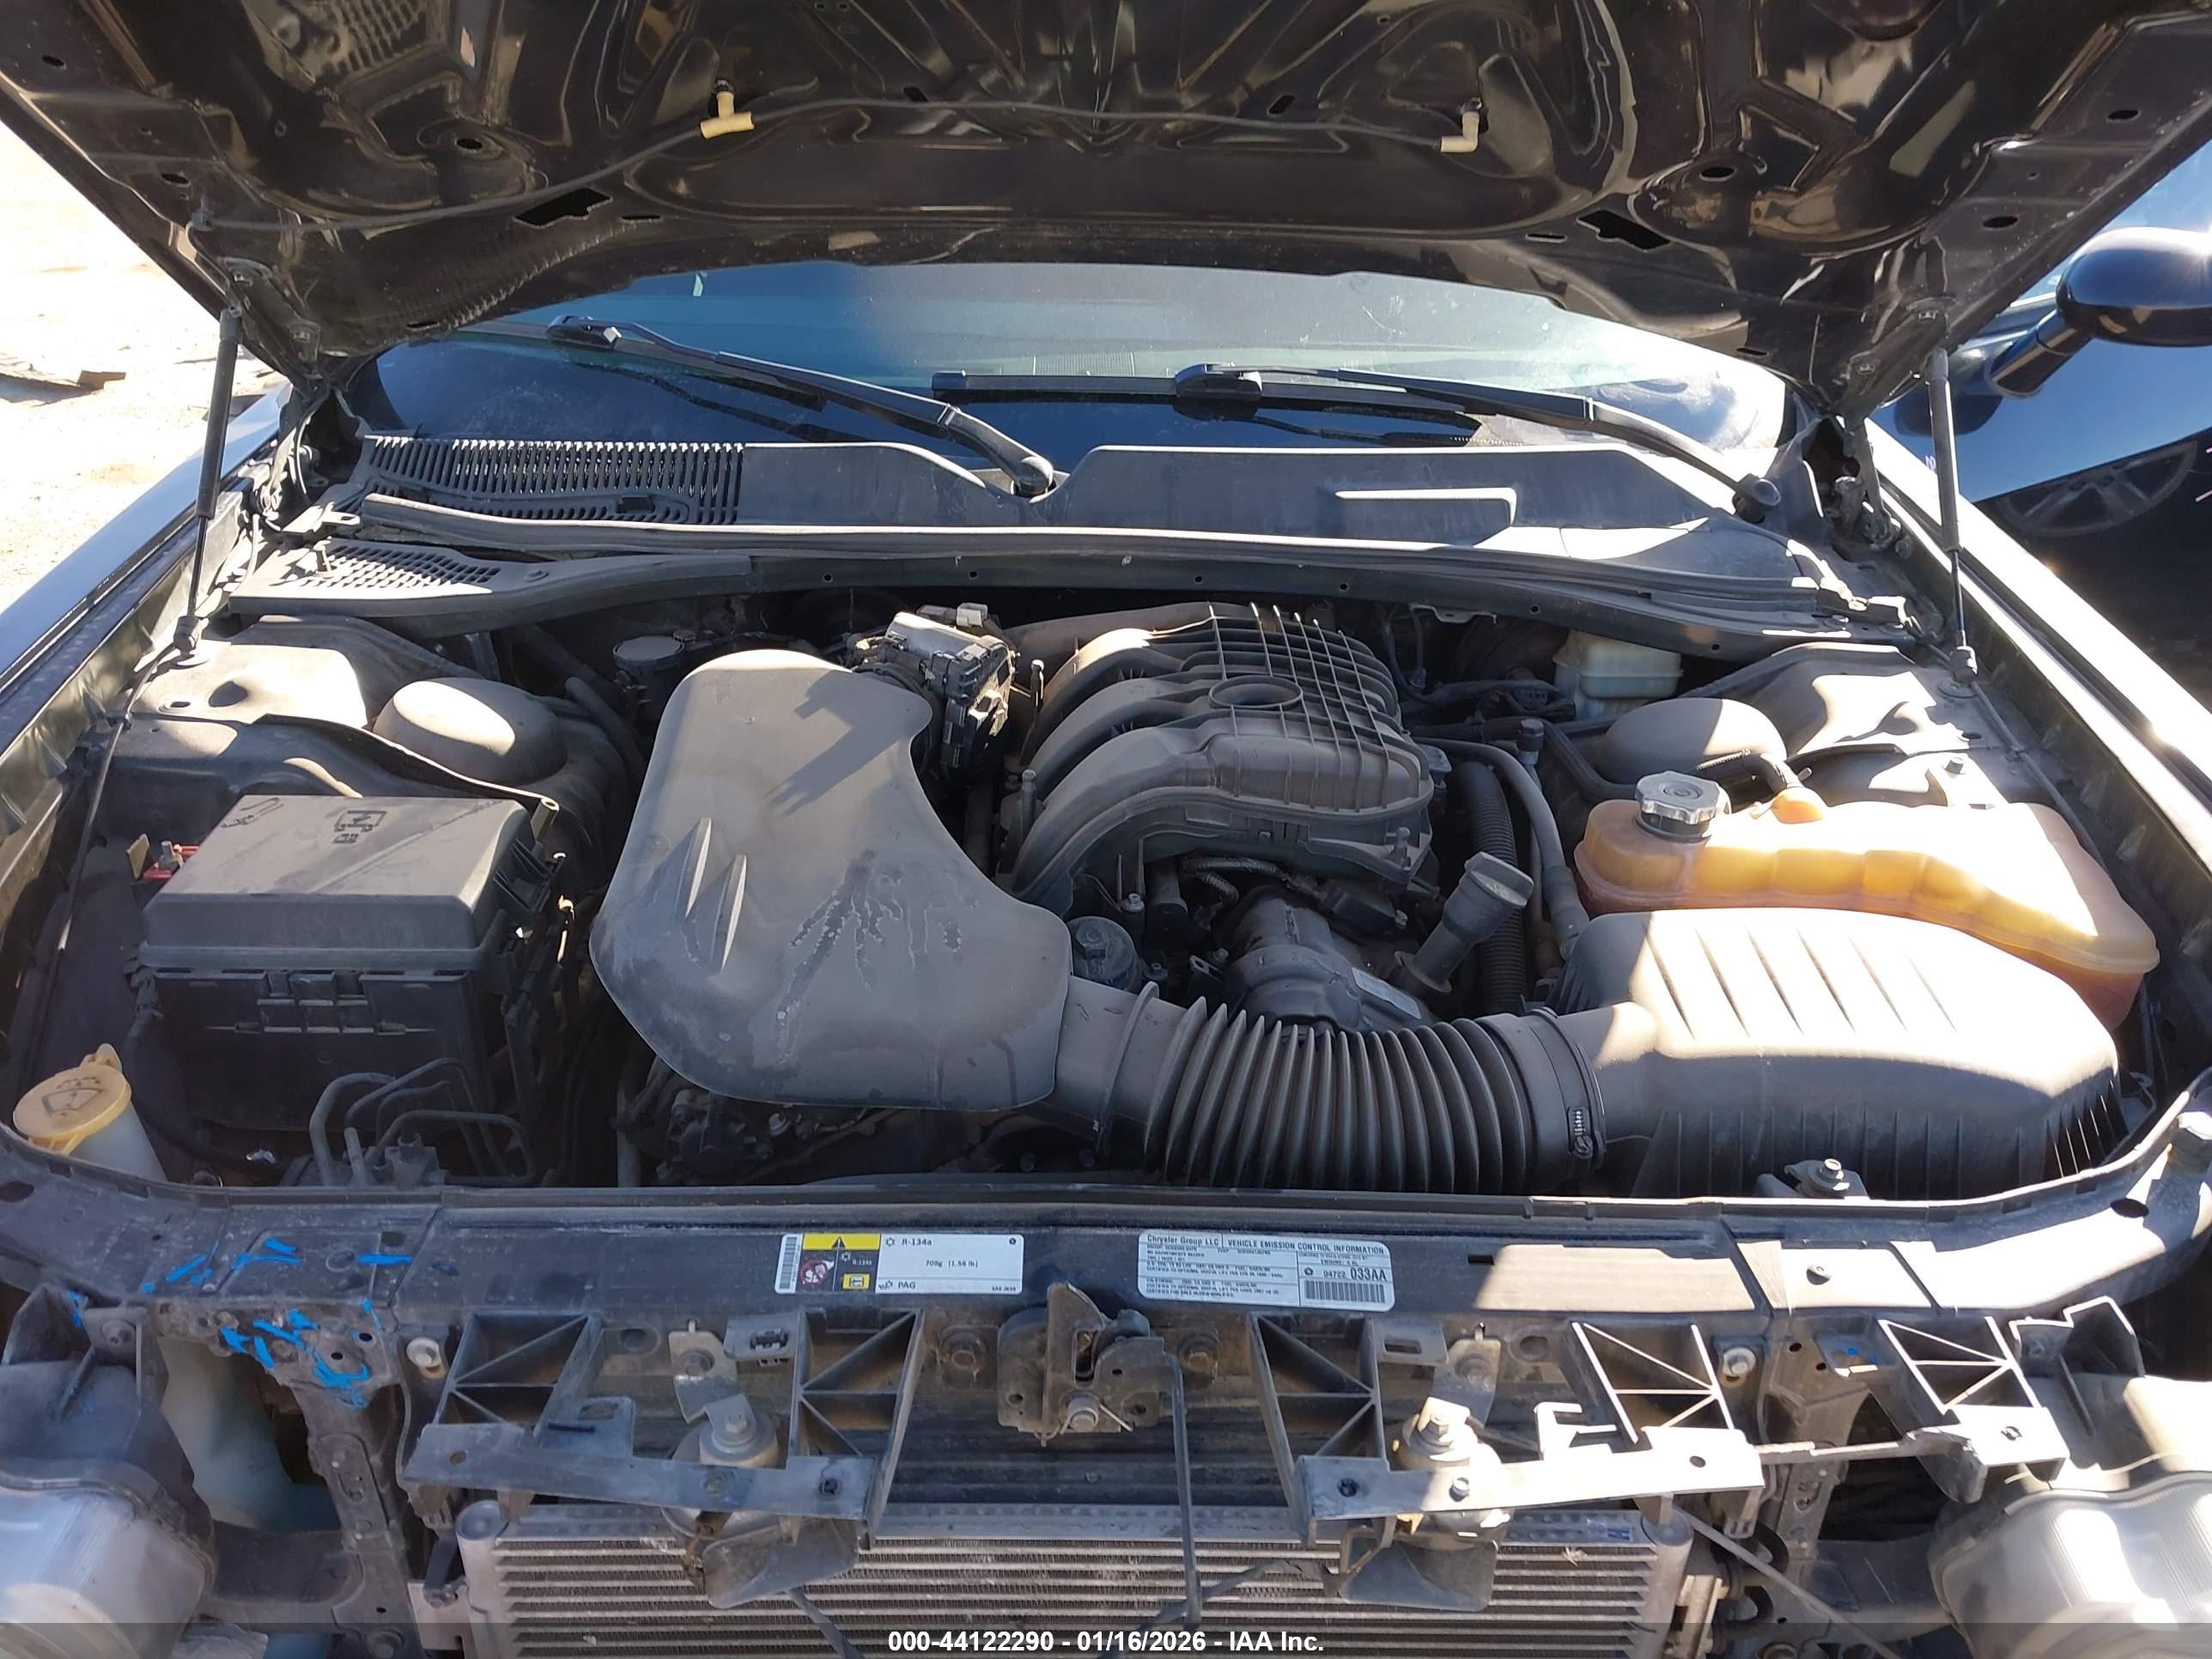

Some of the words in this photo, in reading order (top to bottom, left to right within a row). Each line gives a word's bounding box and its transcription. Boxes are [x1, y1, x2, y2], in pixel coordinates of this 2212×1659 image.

[901, 1237, 933, 1247] R-134a
[1147, 1234, 1178, 1245] Chrysler
[1180, 1236, 1202, 1247] Group
[1205, 1237, 1219, 1246] LLC
[1227, 1238, 1257, 1248] VEHICLE
[1260, 1240, 1295, 1249] EMISSION
[1297, 1242, 1330, 1251] CONTROL
[1334, 1244, 1384, 1255] INFORMATION
[1350, 1267, 1388, 1282] 033AA
[897, 1280, 916, 1290] PAG
